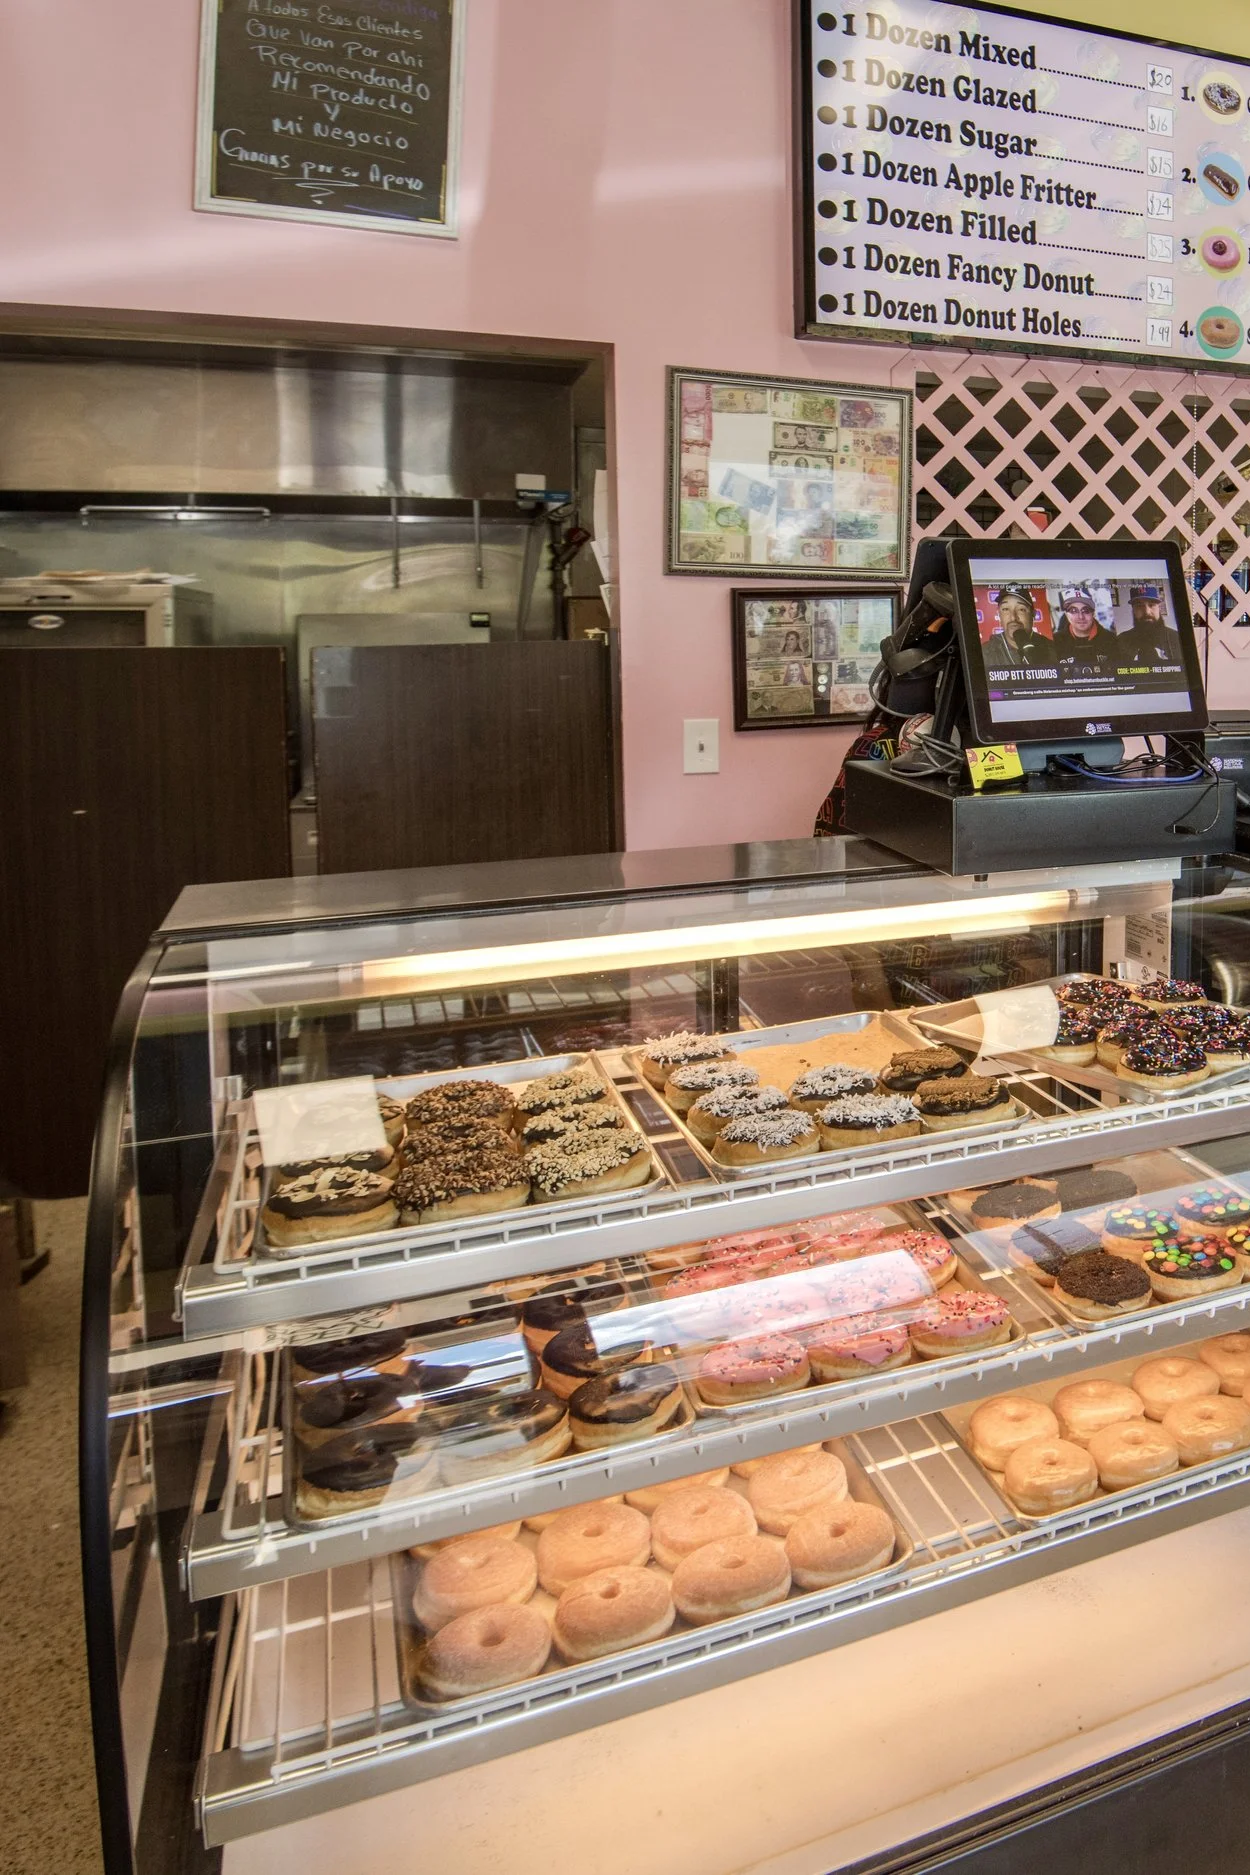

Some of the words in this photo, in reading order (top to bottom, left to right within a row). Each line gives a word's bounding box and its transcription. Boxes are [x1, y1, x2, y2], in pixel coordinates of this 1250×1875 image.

[841, 14, 858, 36] 1
[866, 12, 952, 54] Dozen
[958, 30, 1038, 70] Mixed
[271, 70, 300, 92] Mi
[310, 83, 414, 115] Producto
[841, 58, 857, 82] 1
[865, 57, 946, 98] Dozen
[953, 74, 1037, 114] Glazed
[1149, 67, 1172, 88] $20
[1181, 86, 1196, 102] 1.
[841, 105, 857, 128] 1
[865, 103, 953, 144] Dozen
[958, 119, 1038, 158] Sugar
[1148, 113, 1168, 132] $16
[841, 151, 856, 176] 1
[863, 149, 938, 188] Dozen
[944, 164, 1015, 202] Apple
[1020, 173, 1097, 211] Fritter
[1181, 167, 1197, 184] 2.
[842, 199, 858, 222] 1
[866, 197, 953, 235] Dozen
[960, 210, 1037, 246] Filled
[1181, 238, 1196, 255] 3.
[842, 246, 856, 270] 1
[863, 243, 941, 280] Dozen
[947, 253, 1017, 292] Fancy
[1023, 263, 1096, 297] Donut
[842, 292, 856, 316] 1
[863, 290, 938, 324] Dozen
[944, 297, 1016, 332] Donut
[1022, 306, 1082, 339] Holes
[1179, 320, 1194, 338] 4.
[989, 670, 1010, 682] SHOP
[1010, 669, 1026, 681] BTT
[1026, 668, 1058, 680] STUDIOS
